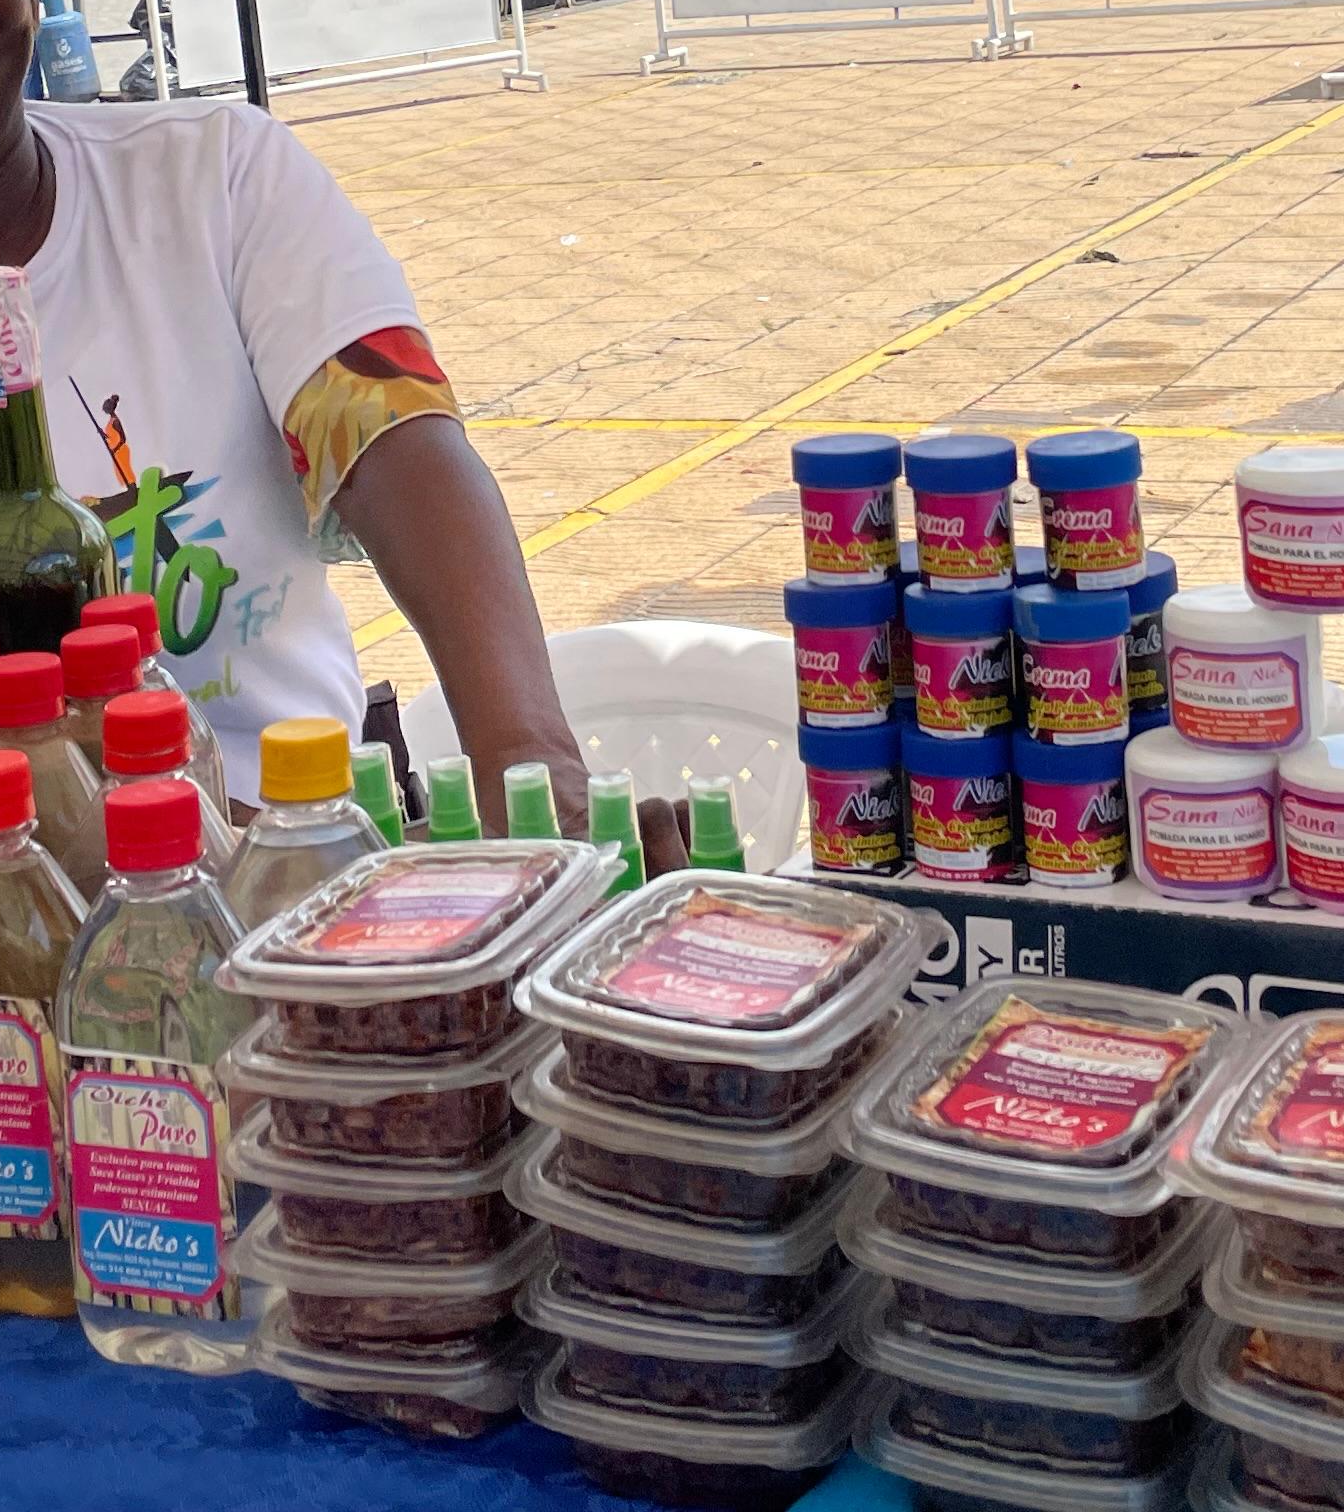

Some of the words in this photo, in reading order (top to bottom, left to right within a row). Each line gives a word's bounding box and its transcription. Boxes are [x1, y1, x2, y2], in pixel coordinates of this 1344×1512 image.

[1247, 505, 1314, 539] Sana
[1283, 547, 1312, 560] PARA
[1313, 549, 1327, 560] EL
[1022, 652, 1091, 690] Crema
[1173, 652, 1236, 685] Sana
[1207, 694, 1235, 705] PARA
[1236, 695, 1251, 706] EL
[1147, 793, 1218, 824] Sana
[1282, 794, 1335, 833] Sana
[1188, 835, 1217, 846] PARA
[1219, 835, 1233, 846] EL
[133, 1109, 198, 1147] Puro
[963, 1096, 1108, 1133] Nicko's
[90, 1151, 139, 1167] Exclusivo
[140, 1157, 165, 1171] para
[93, 1181, 140, 1197] poderoso
[140, 1187, 199, 1204] estimulante
[93, 1217, 199, 1258] Nicko's
